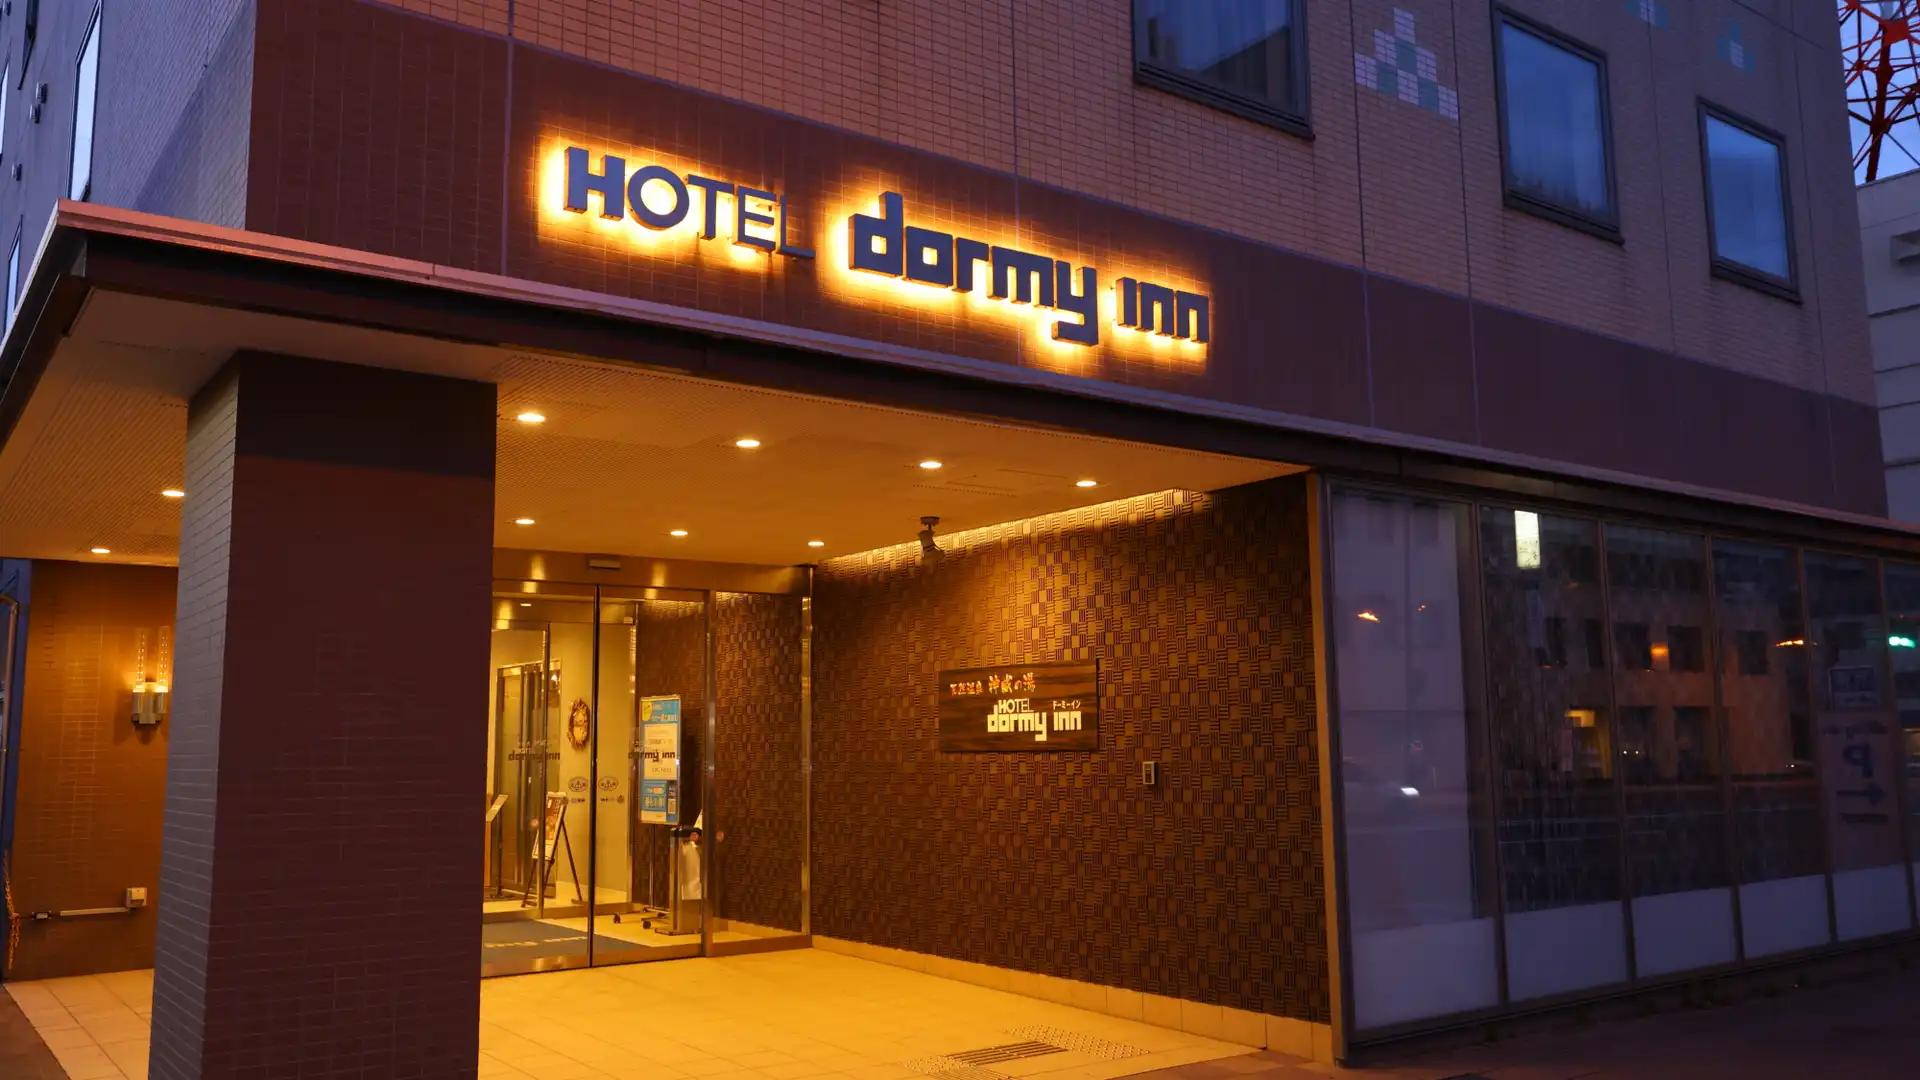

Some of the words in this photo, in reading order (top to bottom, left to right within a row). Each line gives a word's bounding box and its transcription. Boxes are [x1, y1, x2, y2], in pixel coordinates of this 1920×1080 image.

[563, 146, 816, 260] HOTEL
[848, 190, 1099, 348] dormy
[1115, 276, 1210, 344] inn
[987, 705, 1047, 742] dormy
[1053, 711, 1082, 731] inn
[998, 698, 1034, 713] HOTEL
[1052, 700, 1081, 710] ドーミーイン
